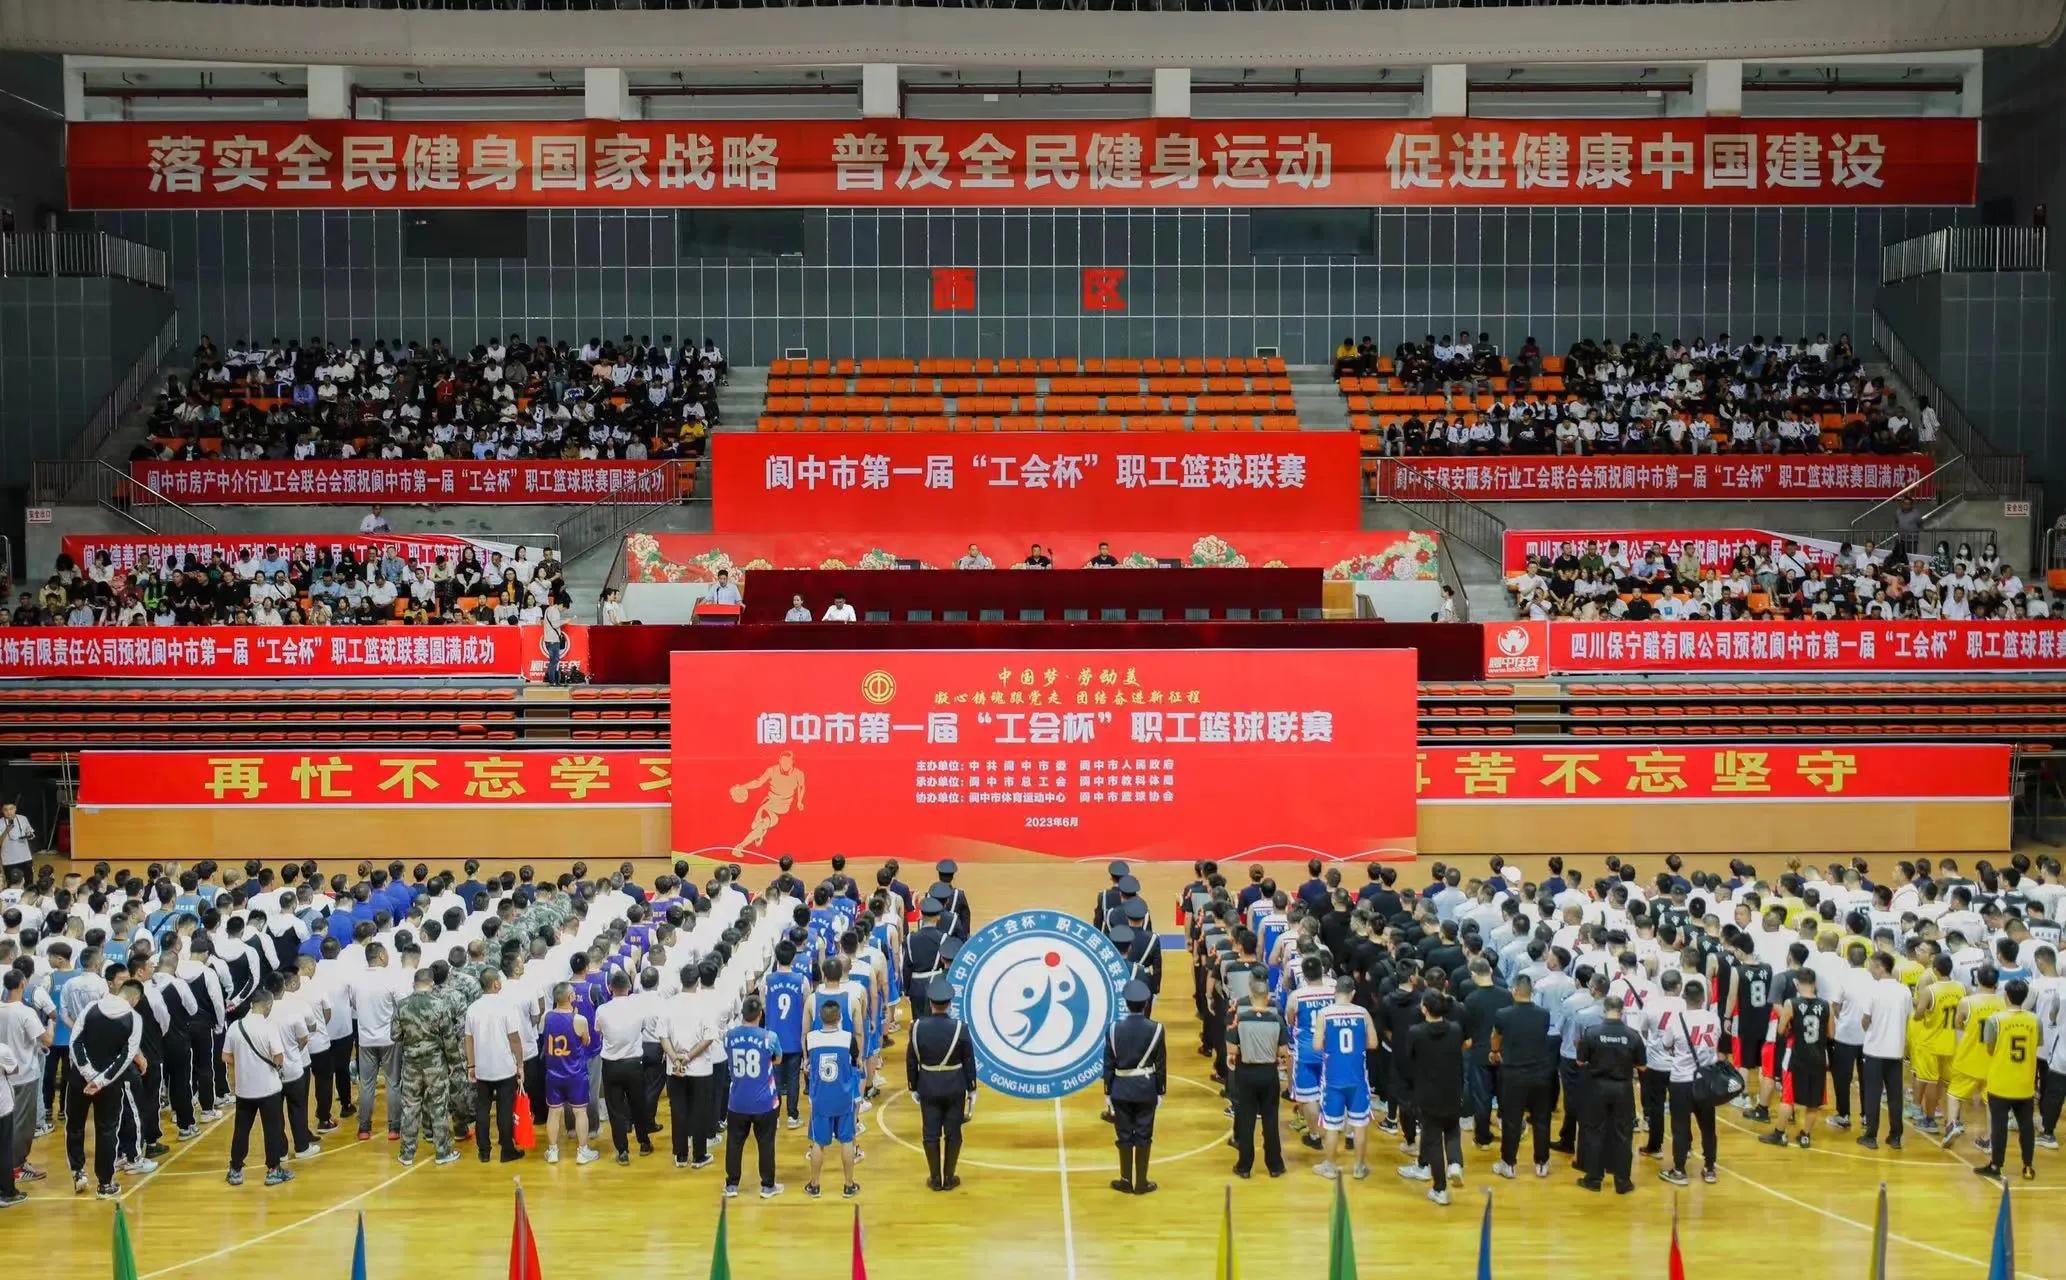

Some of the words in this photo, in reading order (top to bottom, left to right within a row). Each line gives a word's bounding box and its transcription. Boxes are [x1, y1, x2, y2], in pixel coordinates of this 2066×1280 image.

[147, 133, 780, 193] 落实全民健身国家战略
[831, 132, 1333, 191] 普及全民健身运动
[1385, 132, 1886, 190] 促进健康中国建设
[765, 453, 1307, 490] 阆中市第一届“工会杯”职工篮球联赛
[0, 636, 495, 667] 饰有限责任公司预祝阆中市第一届“工会杯”职工篮球联赛圆满成功
[1076, 690, 1201, 705] 团结奋进新征程
[757, 711, 1334, 745] 阆中市第一届“工会杯”职工篮球联赛
[1417, 751, 1858, 794] 苦不忘坚守
[1025, 817, 1079, 828] 2023年6月
[777, 993, 791, 1020] 9
[1750, 980, 1766, 1008] 8
[1339, 1028, 1353, 1054] 0
[1802, 1014, 1820, 1044] 3
[548, 1034, 571, 1057] 12
[2010, 1036, 2027, 1063] 5
[732, 1048, 761, 1079] 58
[818, 1052, 839, 1083] 5
[1018, 1080, 1035, 1092] HUI
[1062, 1076, 1078, 1090] ZHI
